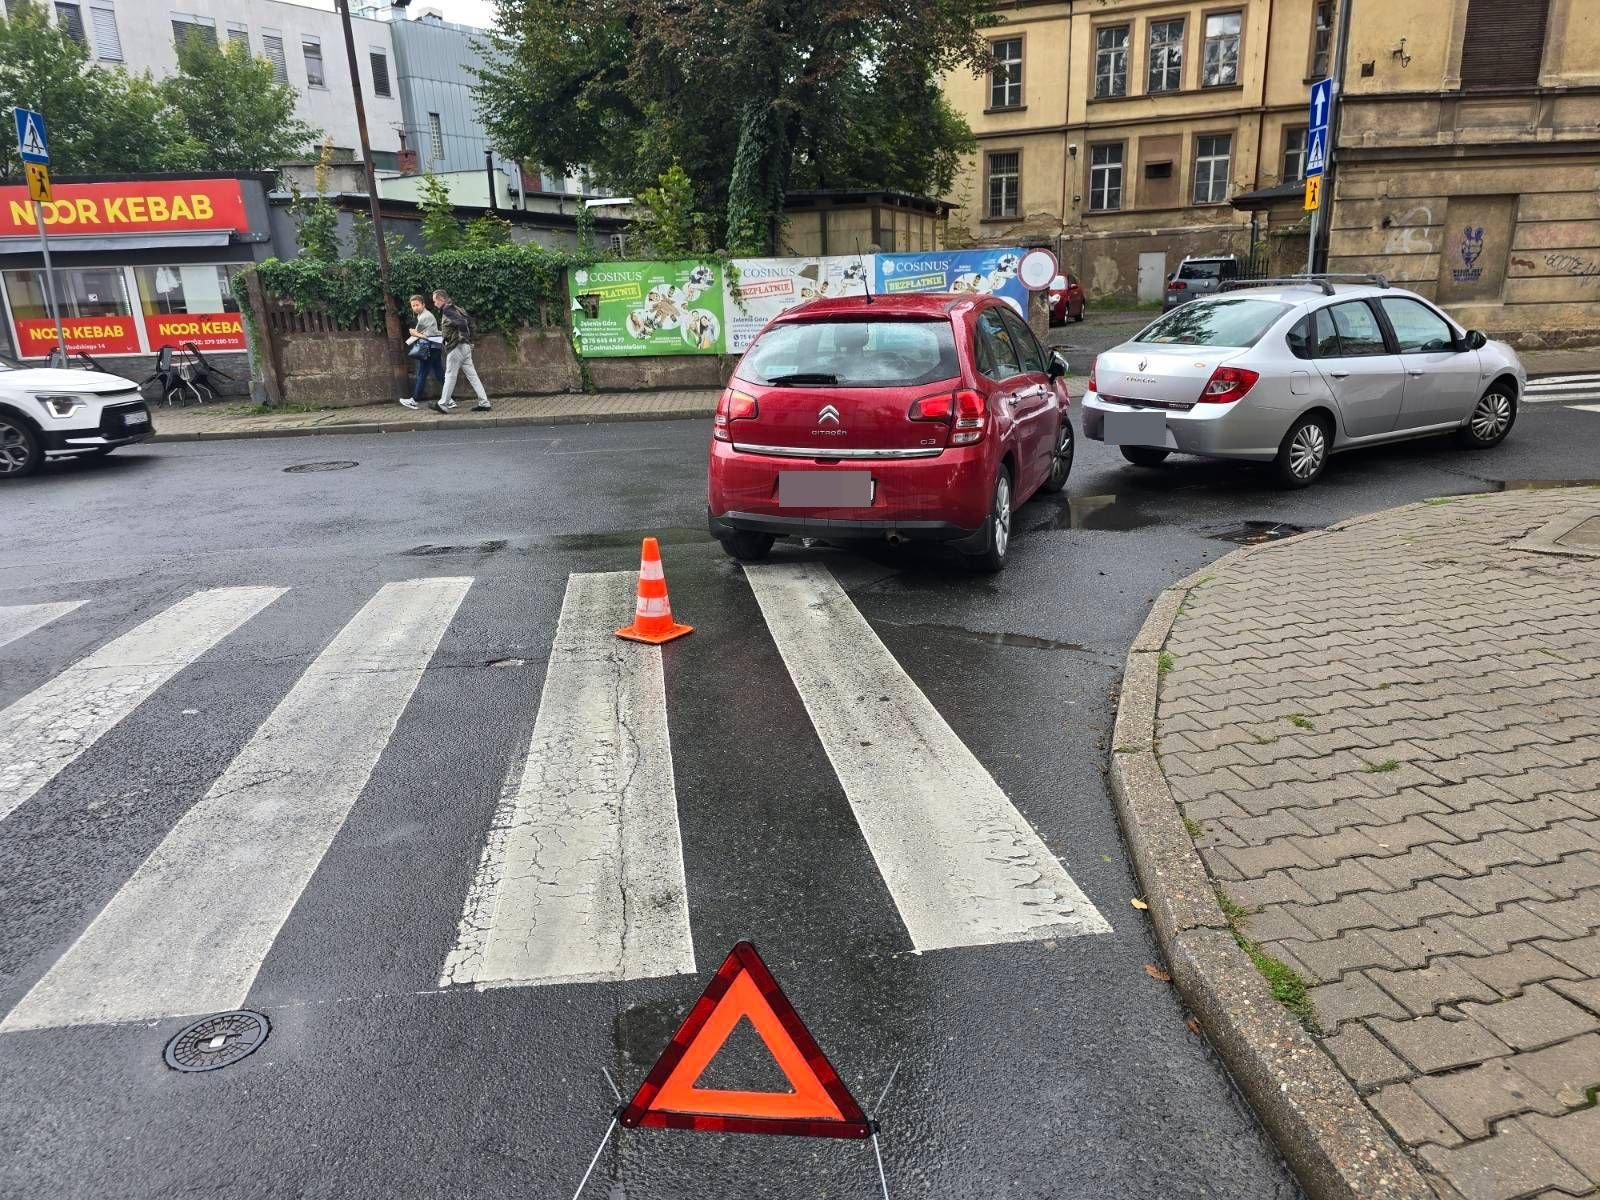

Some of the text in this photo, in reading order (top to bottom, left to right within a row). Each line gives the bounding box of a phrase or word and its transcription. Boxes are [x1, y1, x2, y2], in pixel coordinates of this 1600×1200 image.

[9, 194, 214, 226] NOOR KEBAB
[743, 267, 796, 278] COSINUS
[895, 260, 949, 272] COSINUS
[589, 271, 642, 282] COSINUS
[30, 325, 124, 340] NOOR KEBAB
[159, 321, 243, 335] NOOR KEBA
